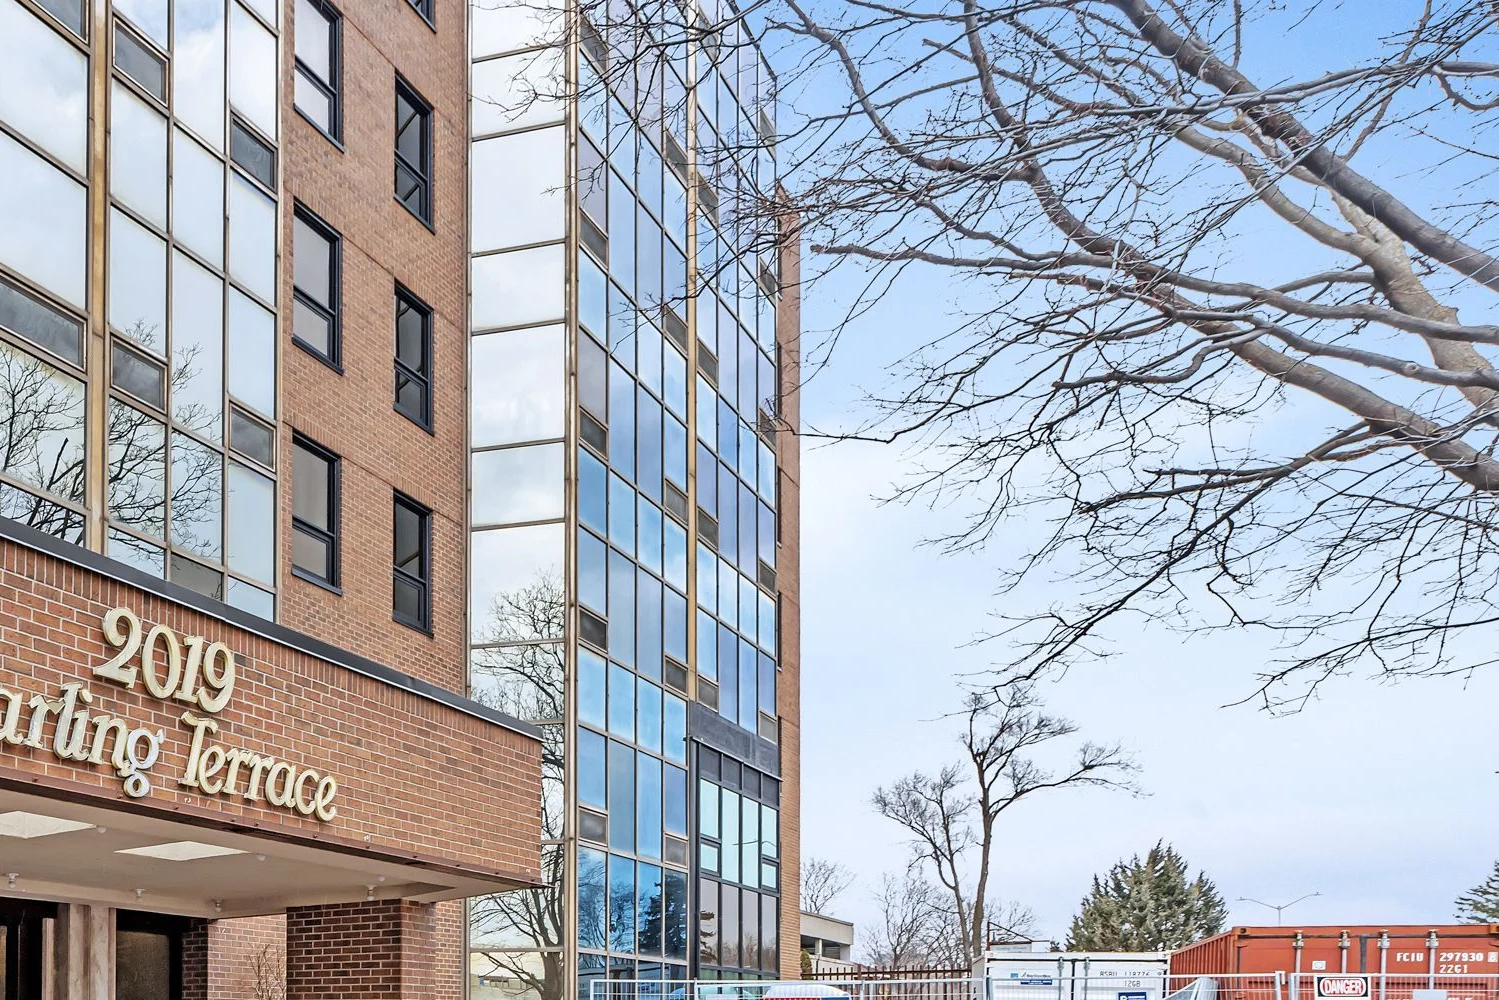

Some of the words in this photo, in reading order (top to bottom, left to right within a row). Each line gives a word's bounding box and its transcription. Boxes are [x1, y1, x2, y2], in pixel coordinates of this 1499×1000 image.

[93, 607, 236, 713] 2019
[178, 711, 338, 821] Terrace
[1396, 952, 1424, 962] FCIU
[1439, 964, 1468, 974] 22G1
[1324, 979, 1362, 994] DANGER
